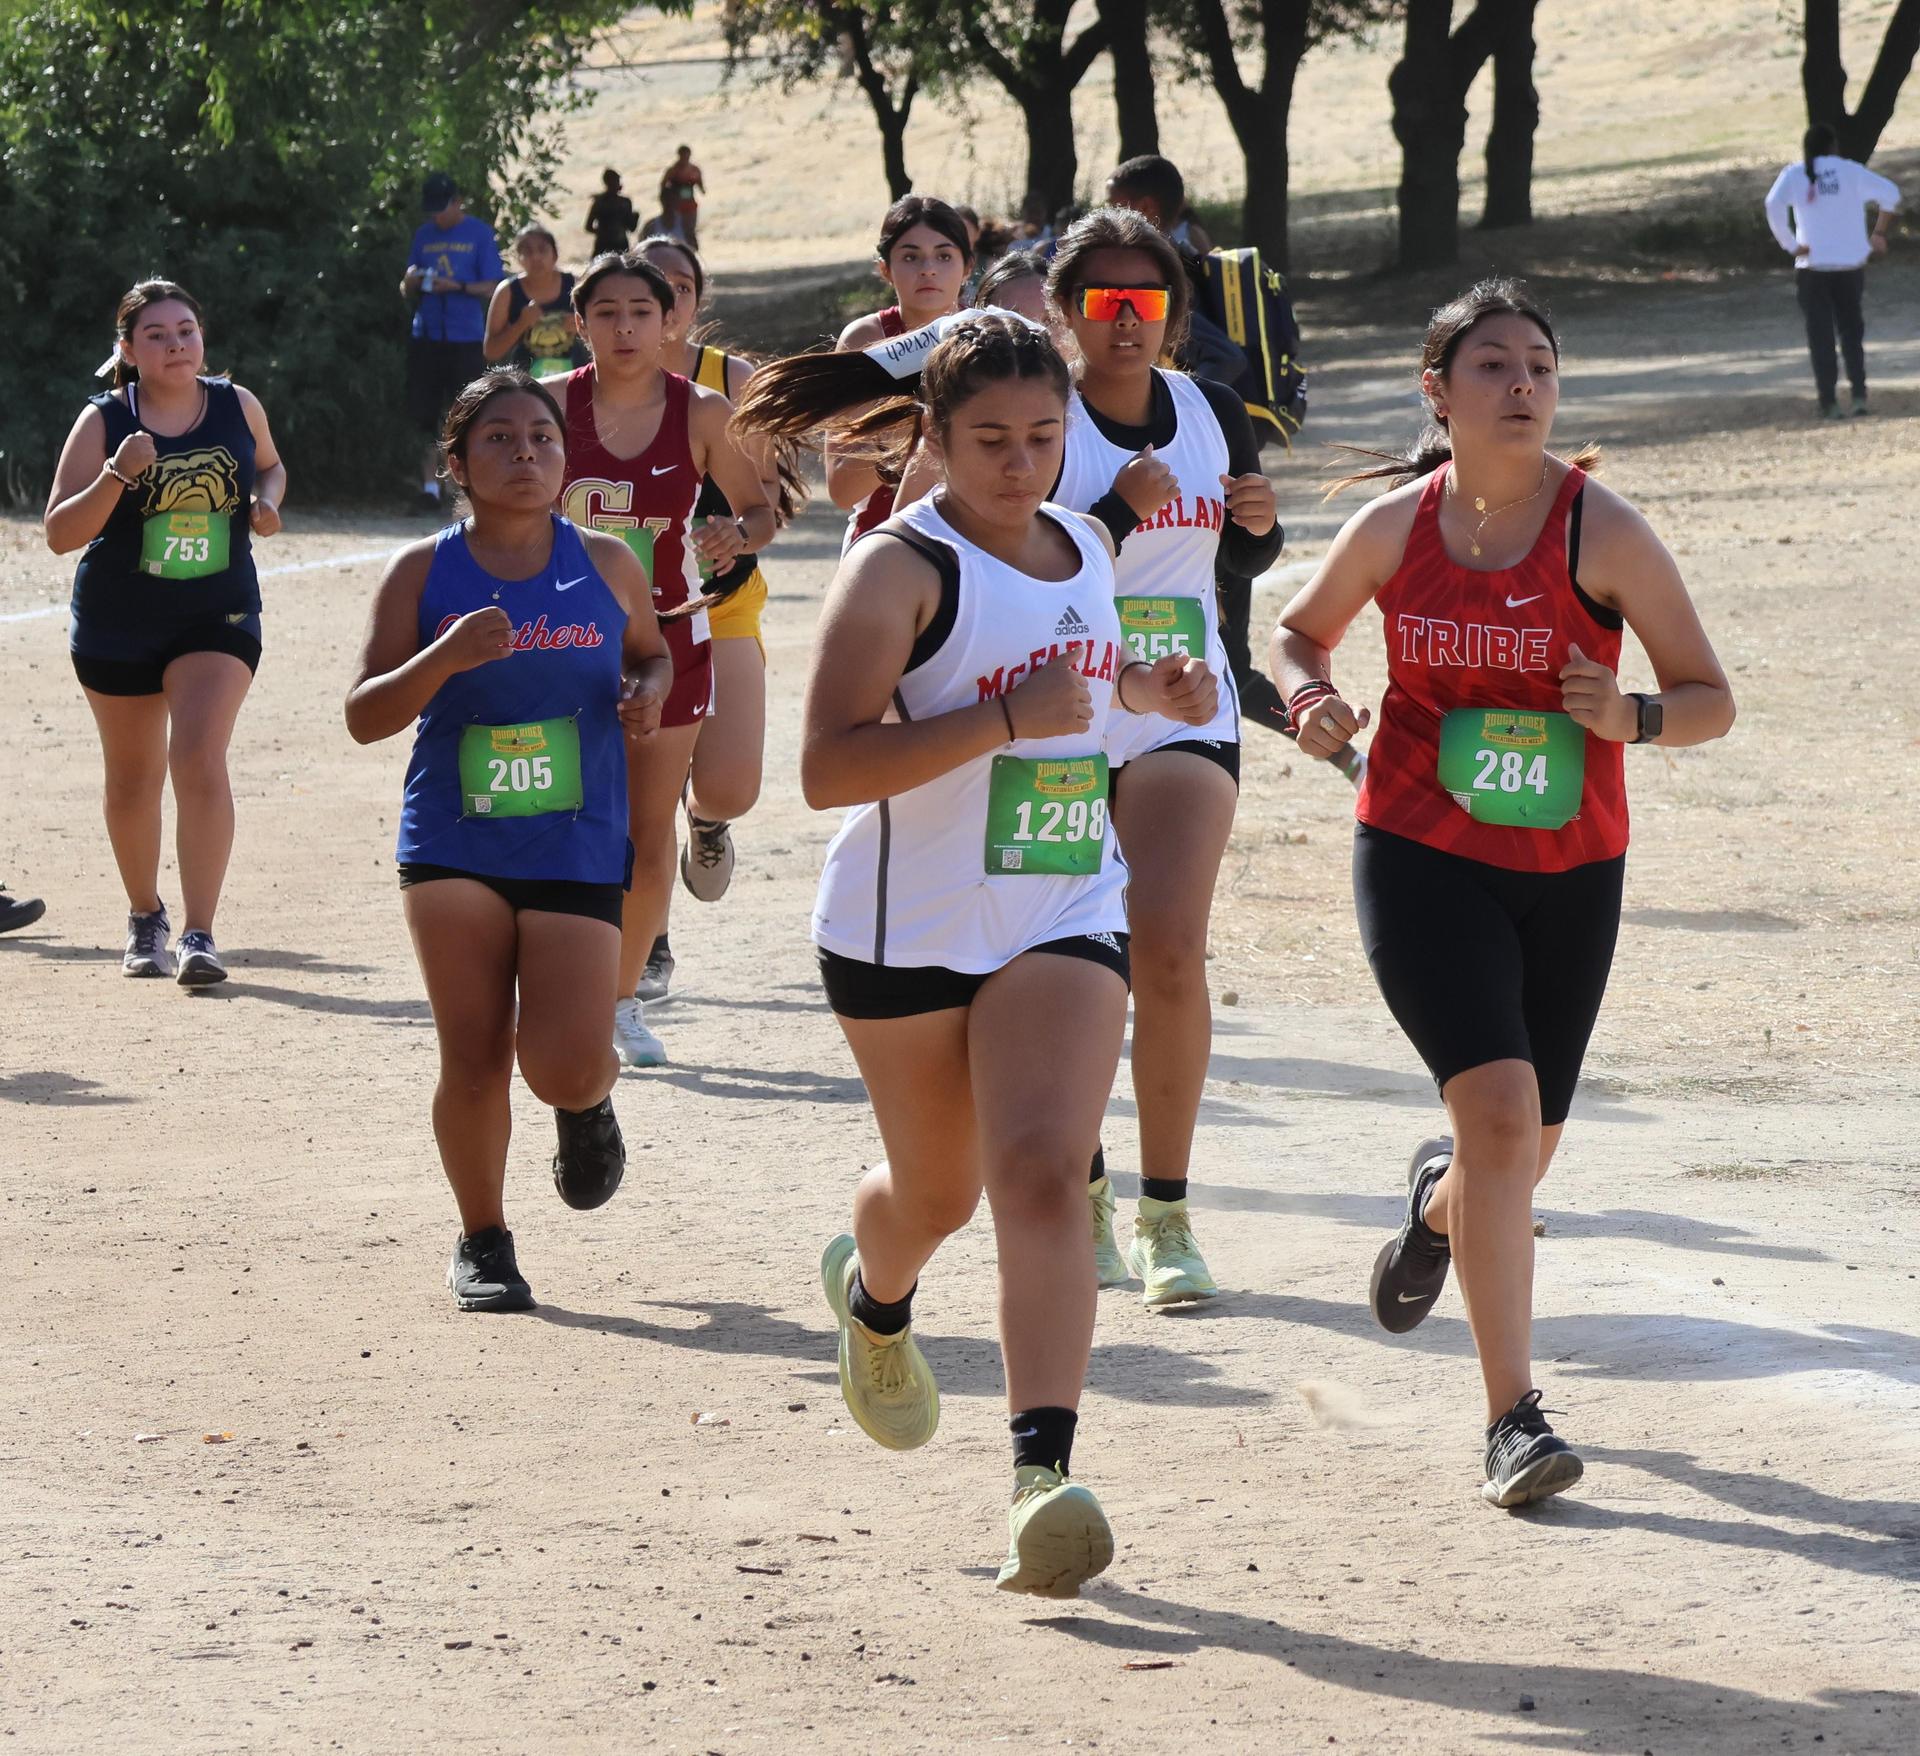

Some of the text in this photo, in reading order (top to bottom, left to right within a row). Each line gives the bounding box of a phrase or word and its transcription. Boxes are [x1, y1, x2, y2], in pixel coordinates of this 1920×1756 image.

[885, 326, 940, 362] Nevaeh
[163, 536, 209, 562] 753
[1055, 624, 1090, 636] adidas
[1398, 613, 1553, 673] TRIBE
[1484, 713, 1546, 731] ROUGH RIDER
[488, 756, 552, 792] 205
[1037, 762, 1069, 778] ROUGH
[1472, 749, 1549, 795] 284
[1012, 797, 1106, 843] 1298
